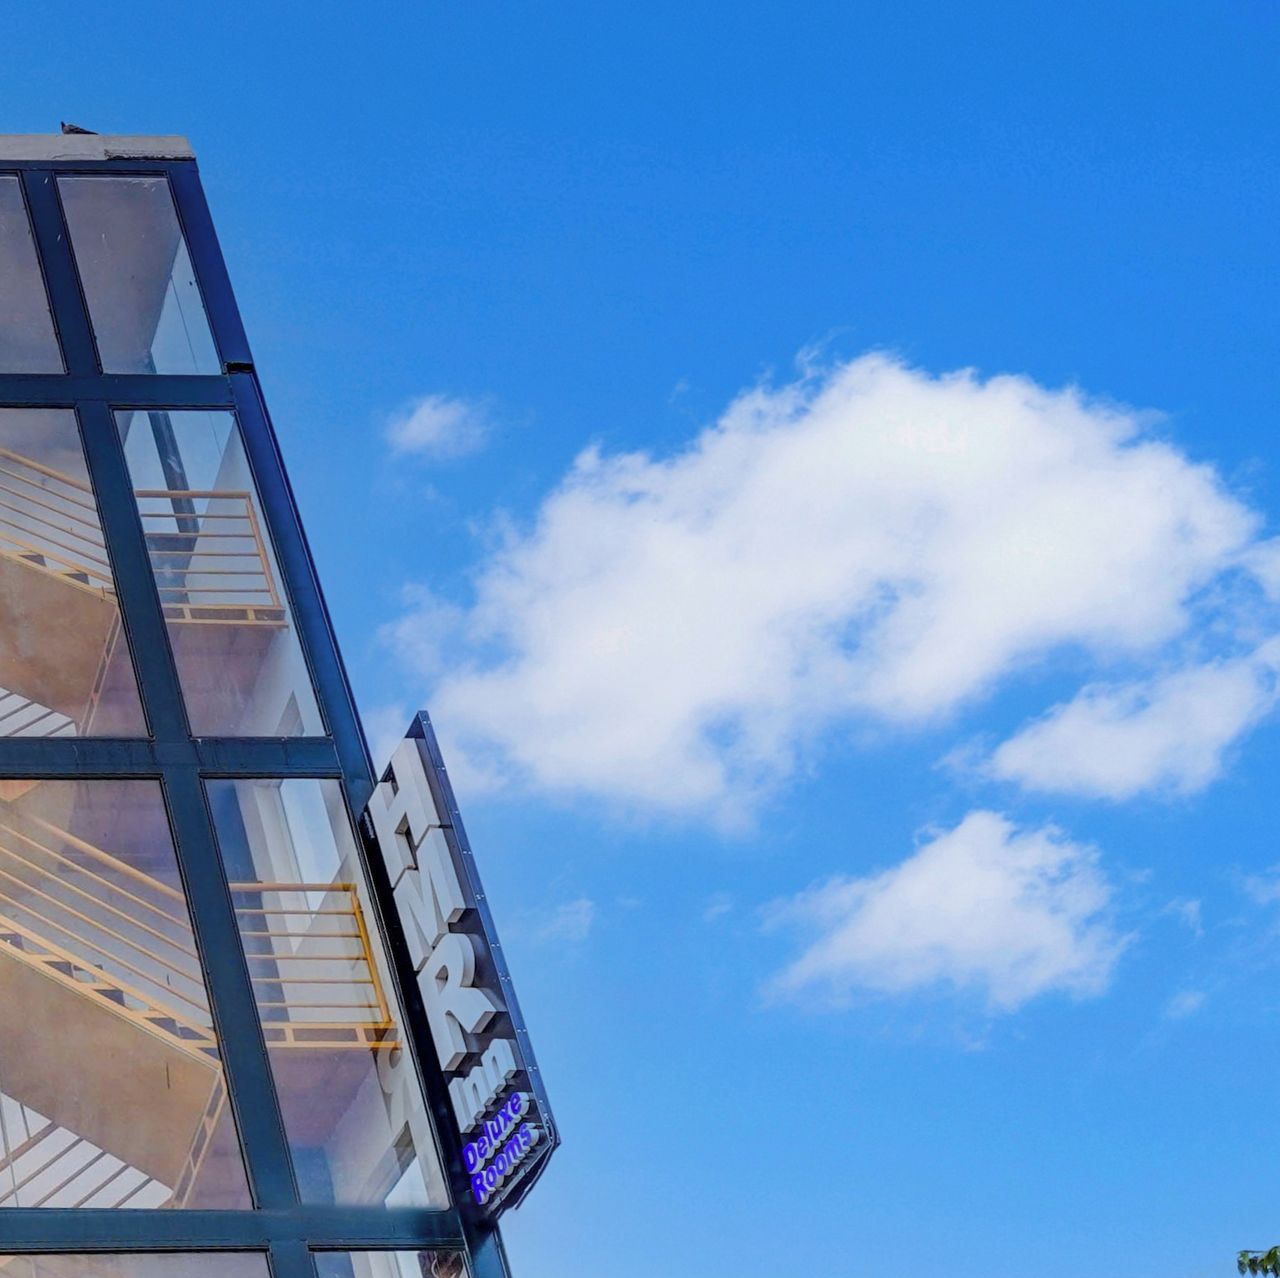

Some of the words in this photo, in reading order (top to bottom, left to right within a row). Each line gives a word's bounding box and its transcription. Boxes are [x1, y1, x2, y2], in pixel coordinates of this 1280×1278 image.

[368, 738, 498, 1071] HMR
[448, 1038, 517, 1133] Inn
[463, 1092, 524, 1174] Deluxe
[471, 1122, 534, 1205] Rooms
